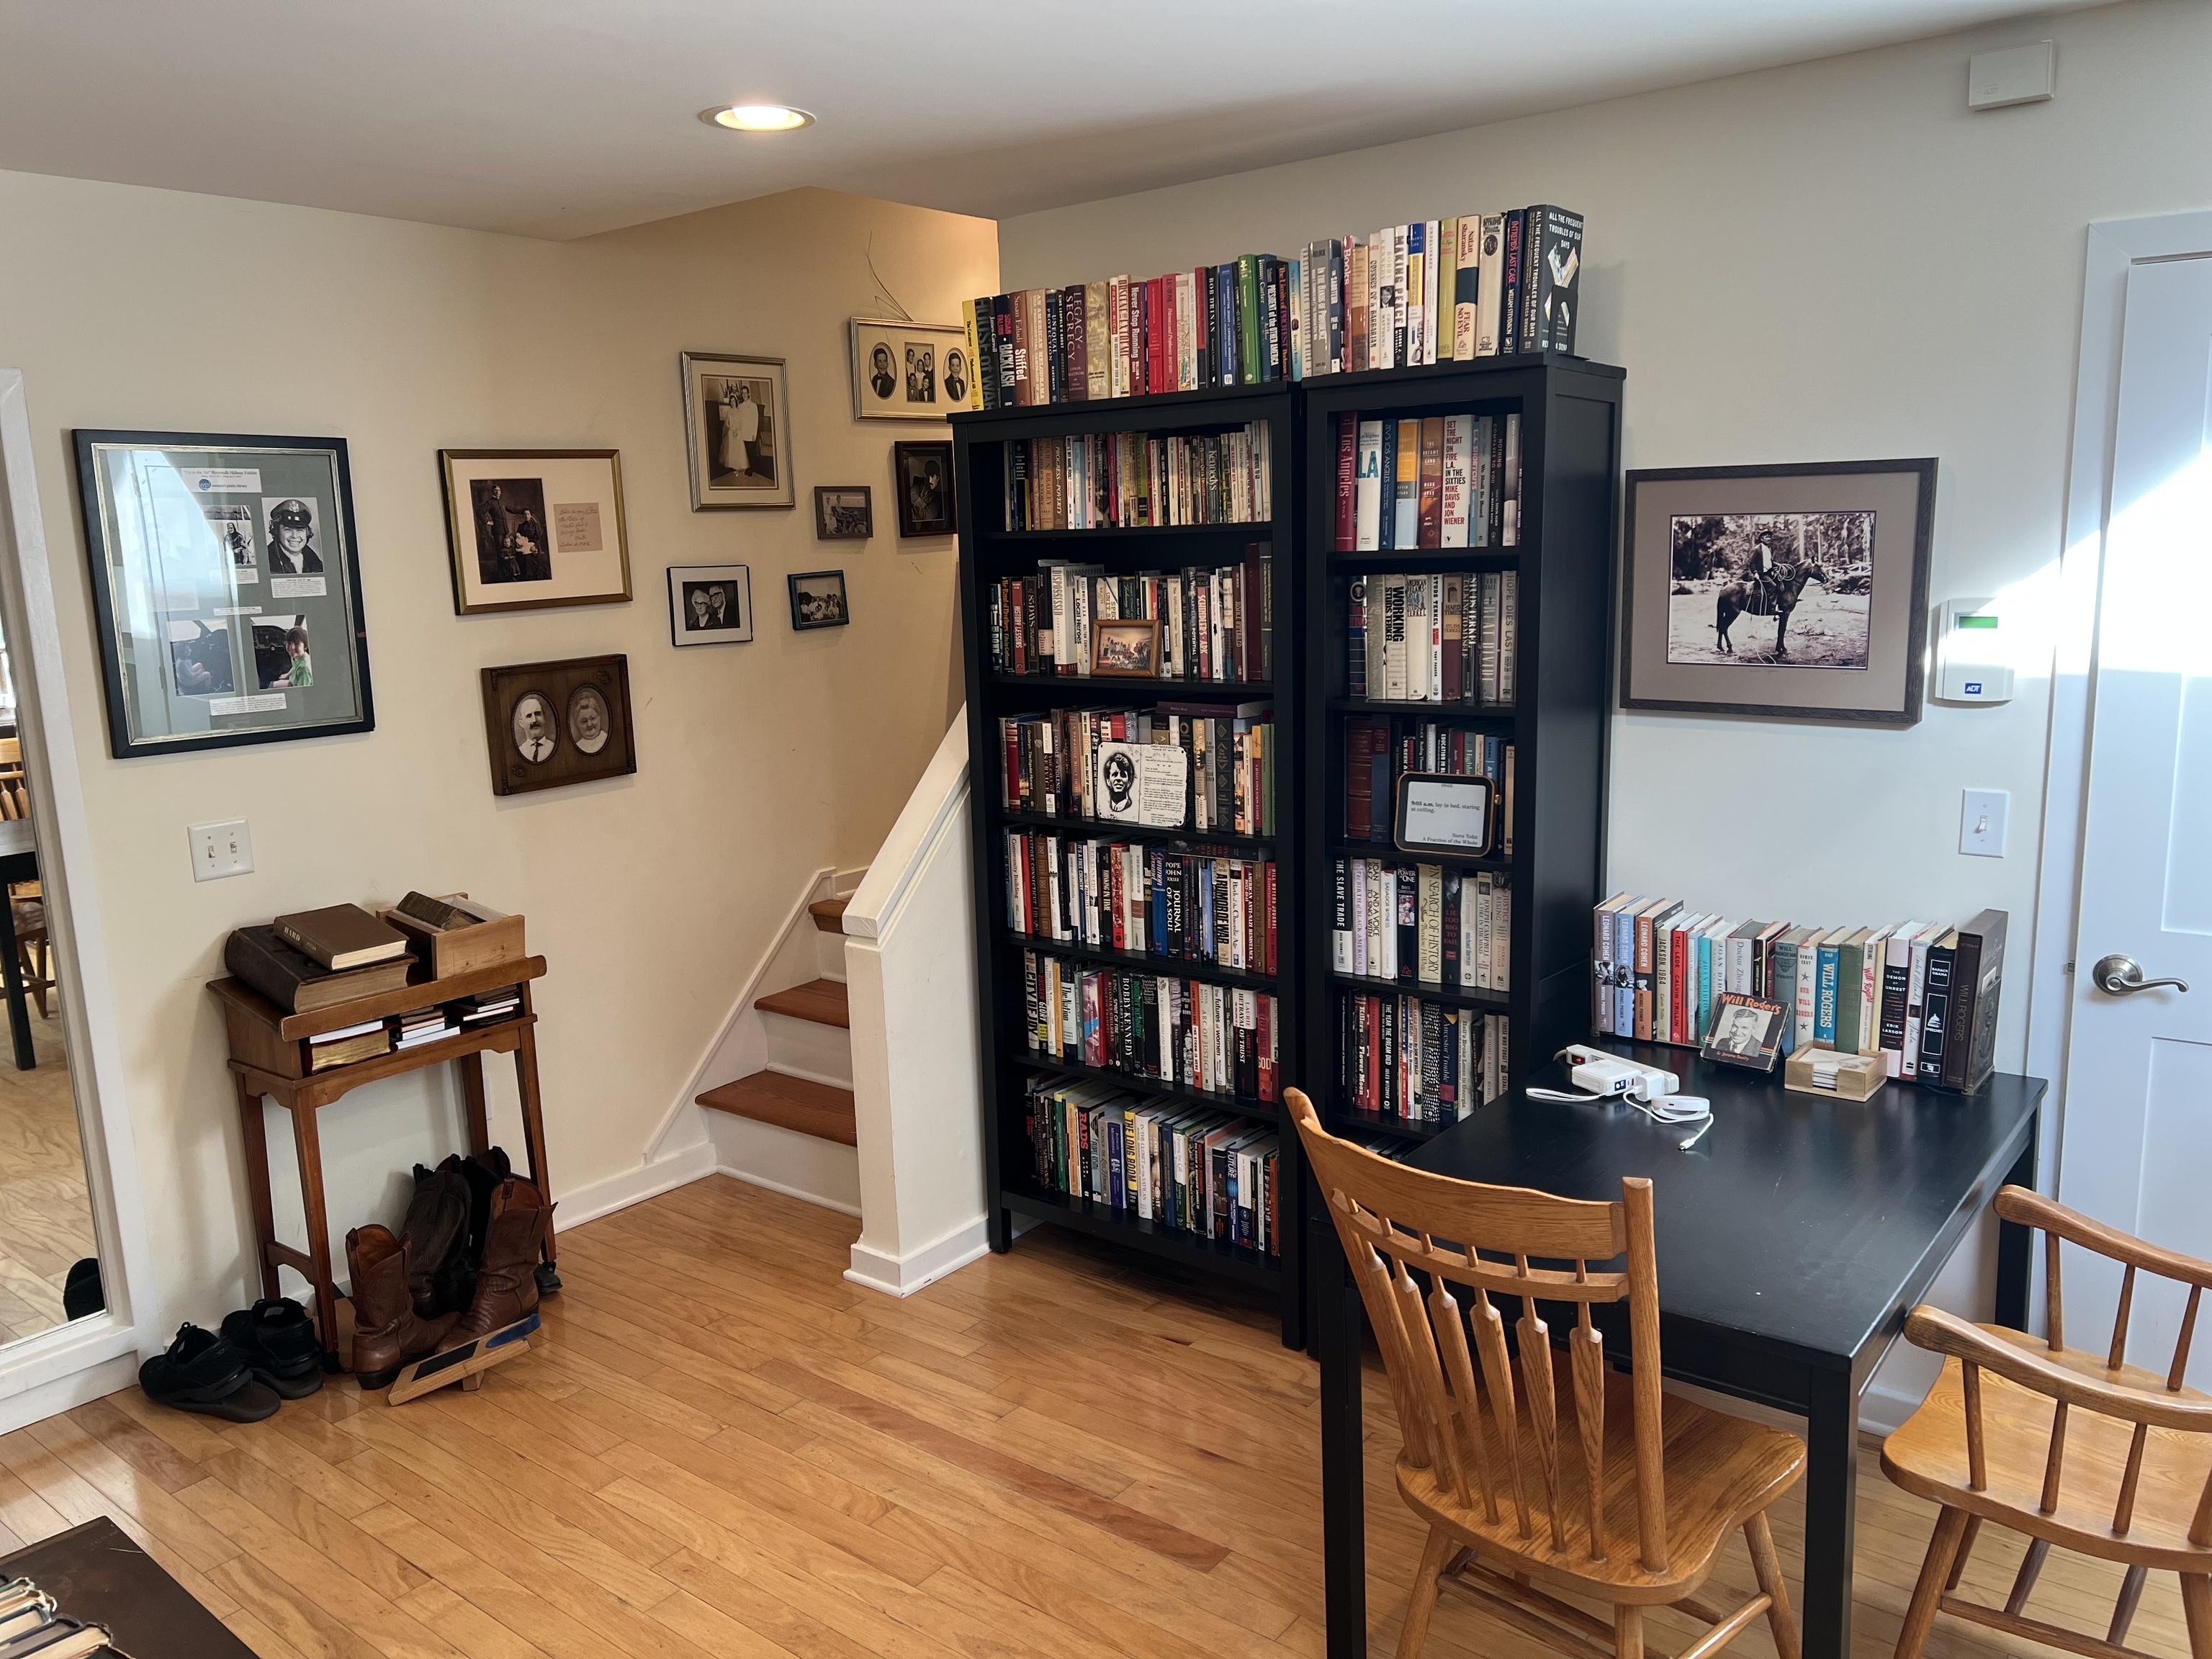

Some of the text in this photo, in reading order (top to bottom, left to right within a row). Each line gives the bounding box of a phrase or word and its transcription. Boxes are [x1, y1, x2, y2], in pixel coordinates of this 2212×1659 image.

[1549, 224, 1569, 237] TROUBLES
[1565, 217, 1583, 228] FREQUENT
[1460, 224, 1468, 262] Sharansky
[1561, 240, 1570, 249] DAYS
[1395, 235, 1404, 328] MAKING PEACE
[1066, 296, 1075, 361] SECRECY
[1074, 292, 1083, 343] LEGACY
[1131, 328, 1140, 359] Running
[999, 343, 1015, 387] BACKLASH
[1015, 349, 1028, 380] Stiffed
[1447, 421, 1457, 429] SET
[1209, 450, 1218, 490] Kennedys
[1339, 434, 1353, 497] Los Angeles
[1359, 451, 1379, 478] LA
[1444, 517, 1465, 526] WIENER
[1052, 570, 1064, 616] DISPOSSESSED
[1393, 587, 1404, 642] WORKING
[1166, 887, 1172, 900] OF
[1173, 889, 1182, 933] JOURNAL
[284, 926, 300, 942] HARD
[1429, 868, 1439, 974] IN SEARCH OF HISTORY
[1062, 986, 1072, 1021] The Nation
[1820, 963, 1835, 1028] WILL ROGERS
[1954, 984, 1969, 1041] WILL ROGERS
[1202, 1028, 1208, 1039] OF
[1258, 1057, 1271, 1070] GOD
[1079, 1112, 1089, 1150] RADS
[1125, 1119, 1136, 1182] THE LONG BOOM
